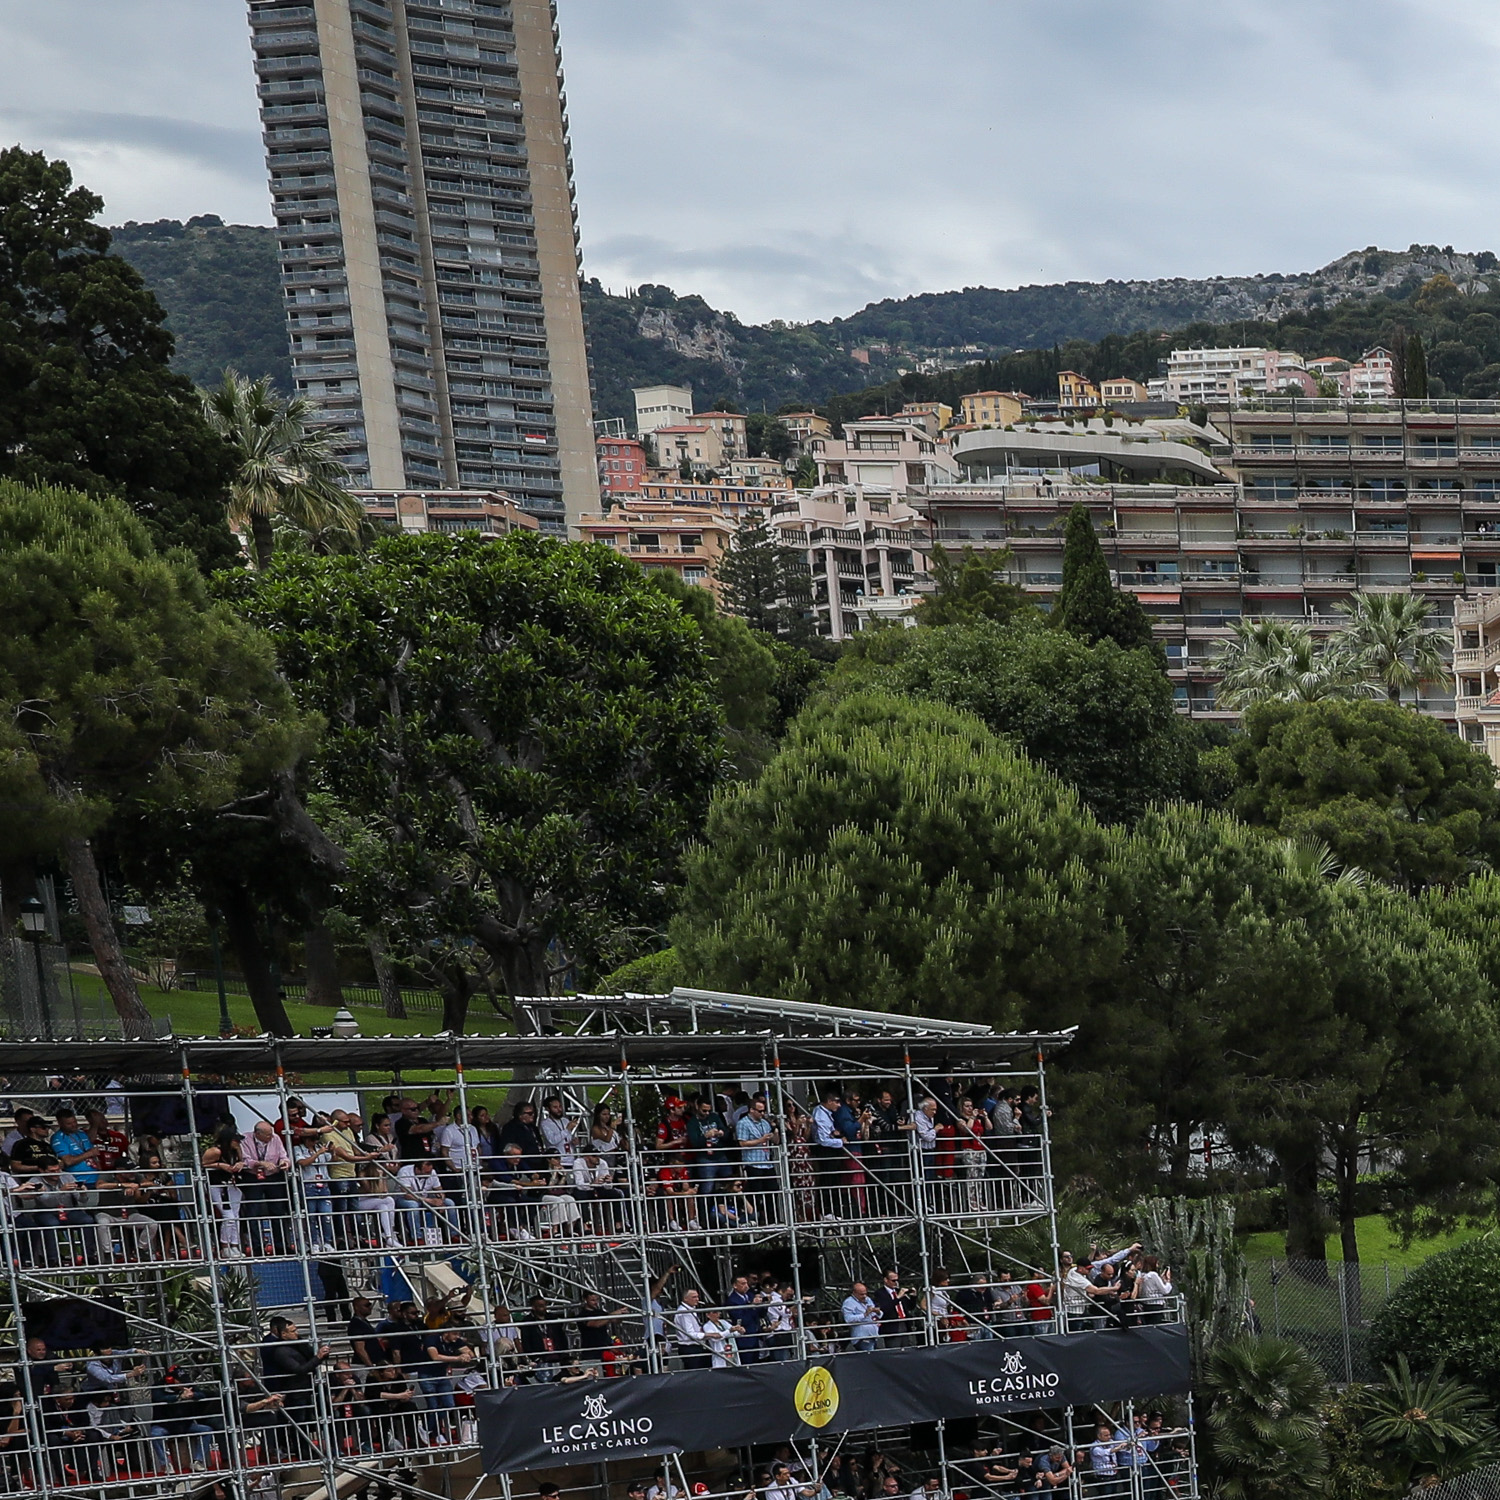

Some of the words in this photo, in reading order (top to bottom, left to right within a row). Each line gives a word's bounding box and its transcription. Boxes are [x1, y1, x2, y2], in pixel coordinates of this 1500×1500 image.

[969, 1380, 988, 1396] LE
[989, 1372, 1060, 1394] CASINO
[541, 1426, 564, 1444] LE
[567, 1415, 654, 1441] CASINO
